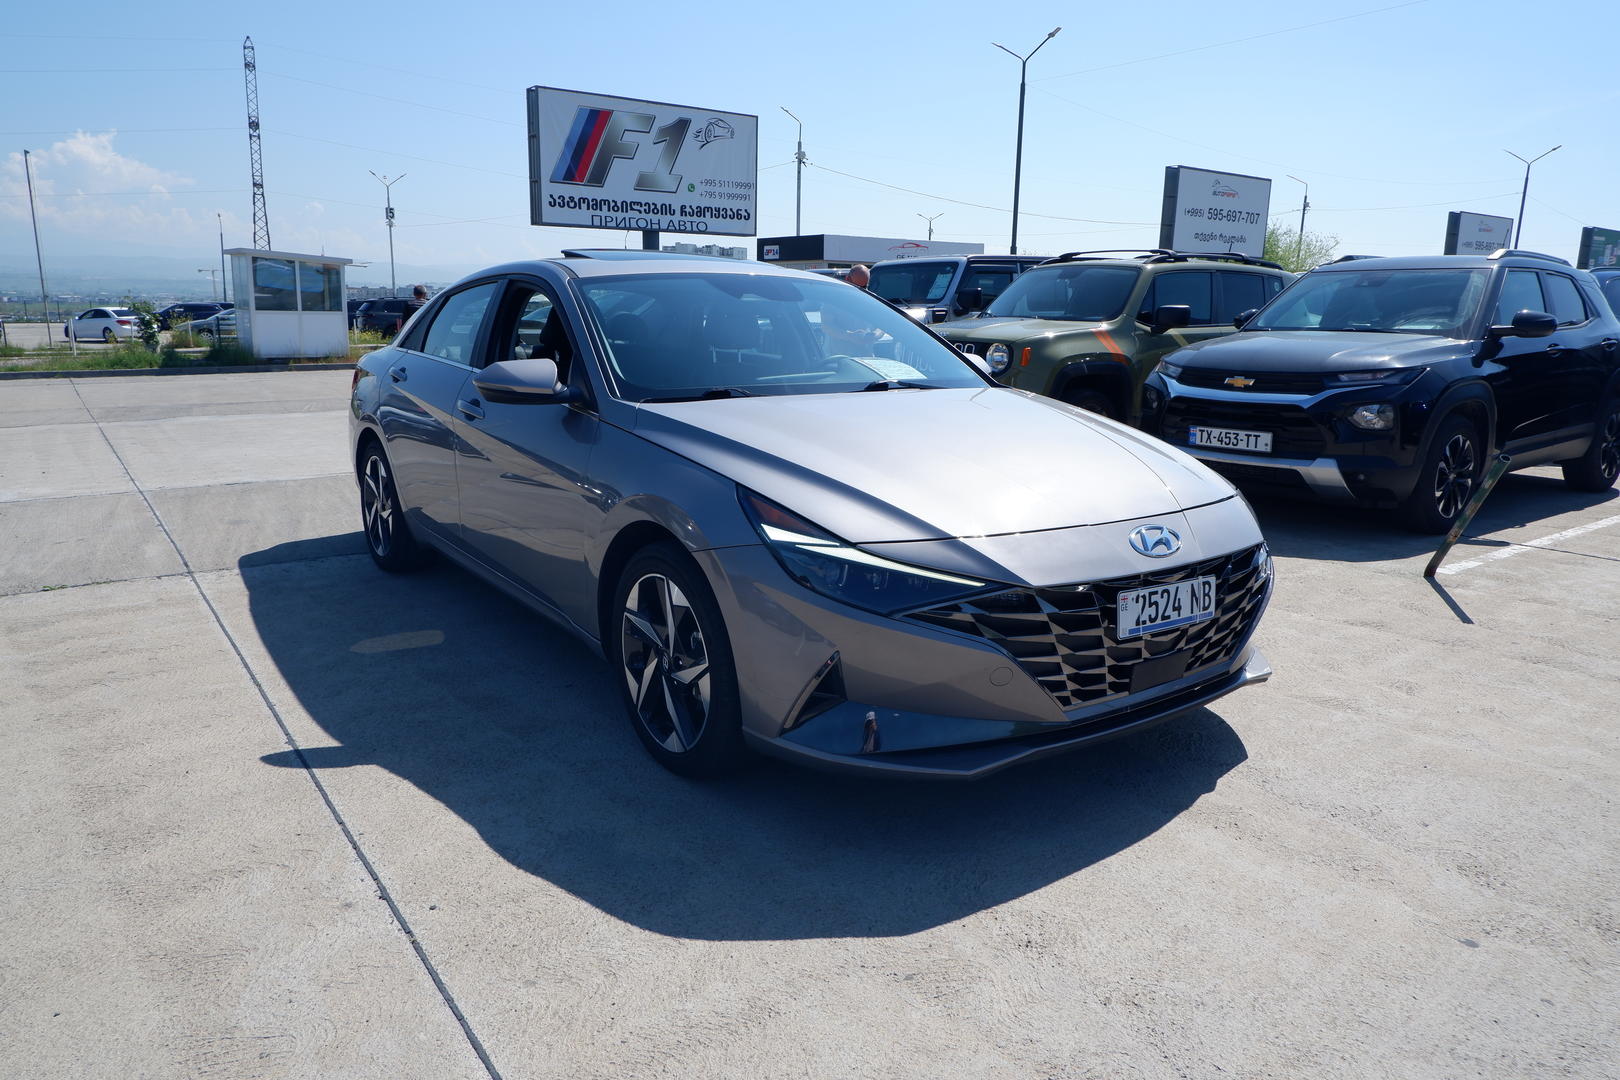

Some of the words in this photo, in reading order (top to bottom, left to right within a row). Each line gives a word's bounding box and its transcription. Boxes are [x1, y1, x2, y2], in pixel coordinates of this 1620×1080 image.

[583, 108, 692, 194] F1
[700, 178, 717, 188] +995
[700, 190, 717, 199] +795
[548, 194, 676, 216] ავტომობილების
[680, 204, 751, 221] ჩამოყვანა
[1184, 207, 1205, 218] (+995)
[1207, 207, 1260, 225] 595-697-707
[591, 214, 661, 230] ПРИГОН
[666, 219, 709, 232] АВТО
[1198, 429, 1261, 449] TX-453-TT
[1120, 603, 1129, 612] GE
[1135, 586, 1182, 627] 2524
[1190, 580, 1212, 615] NB
